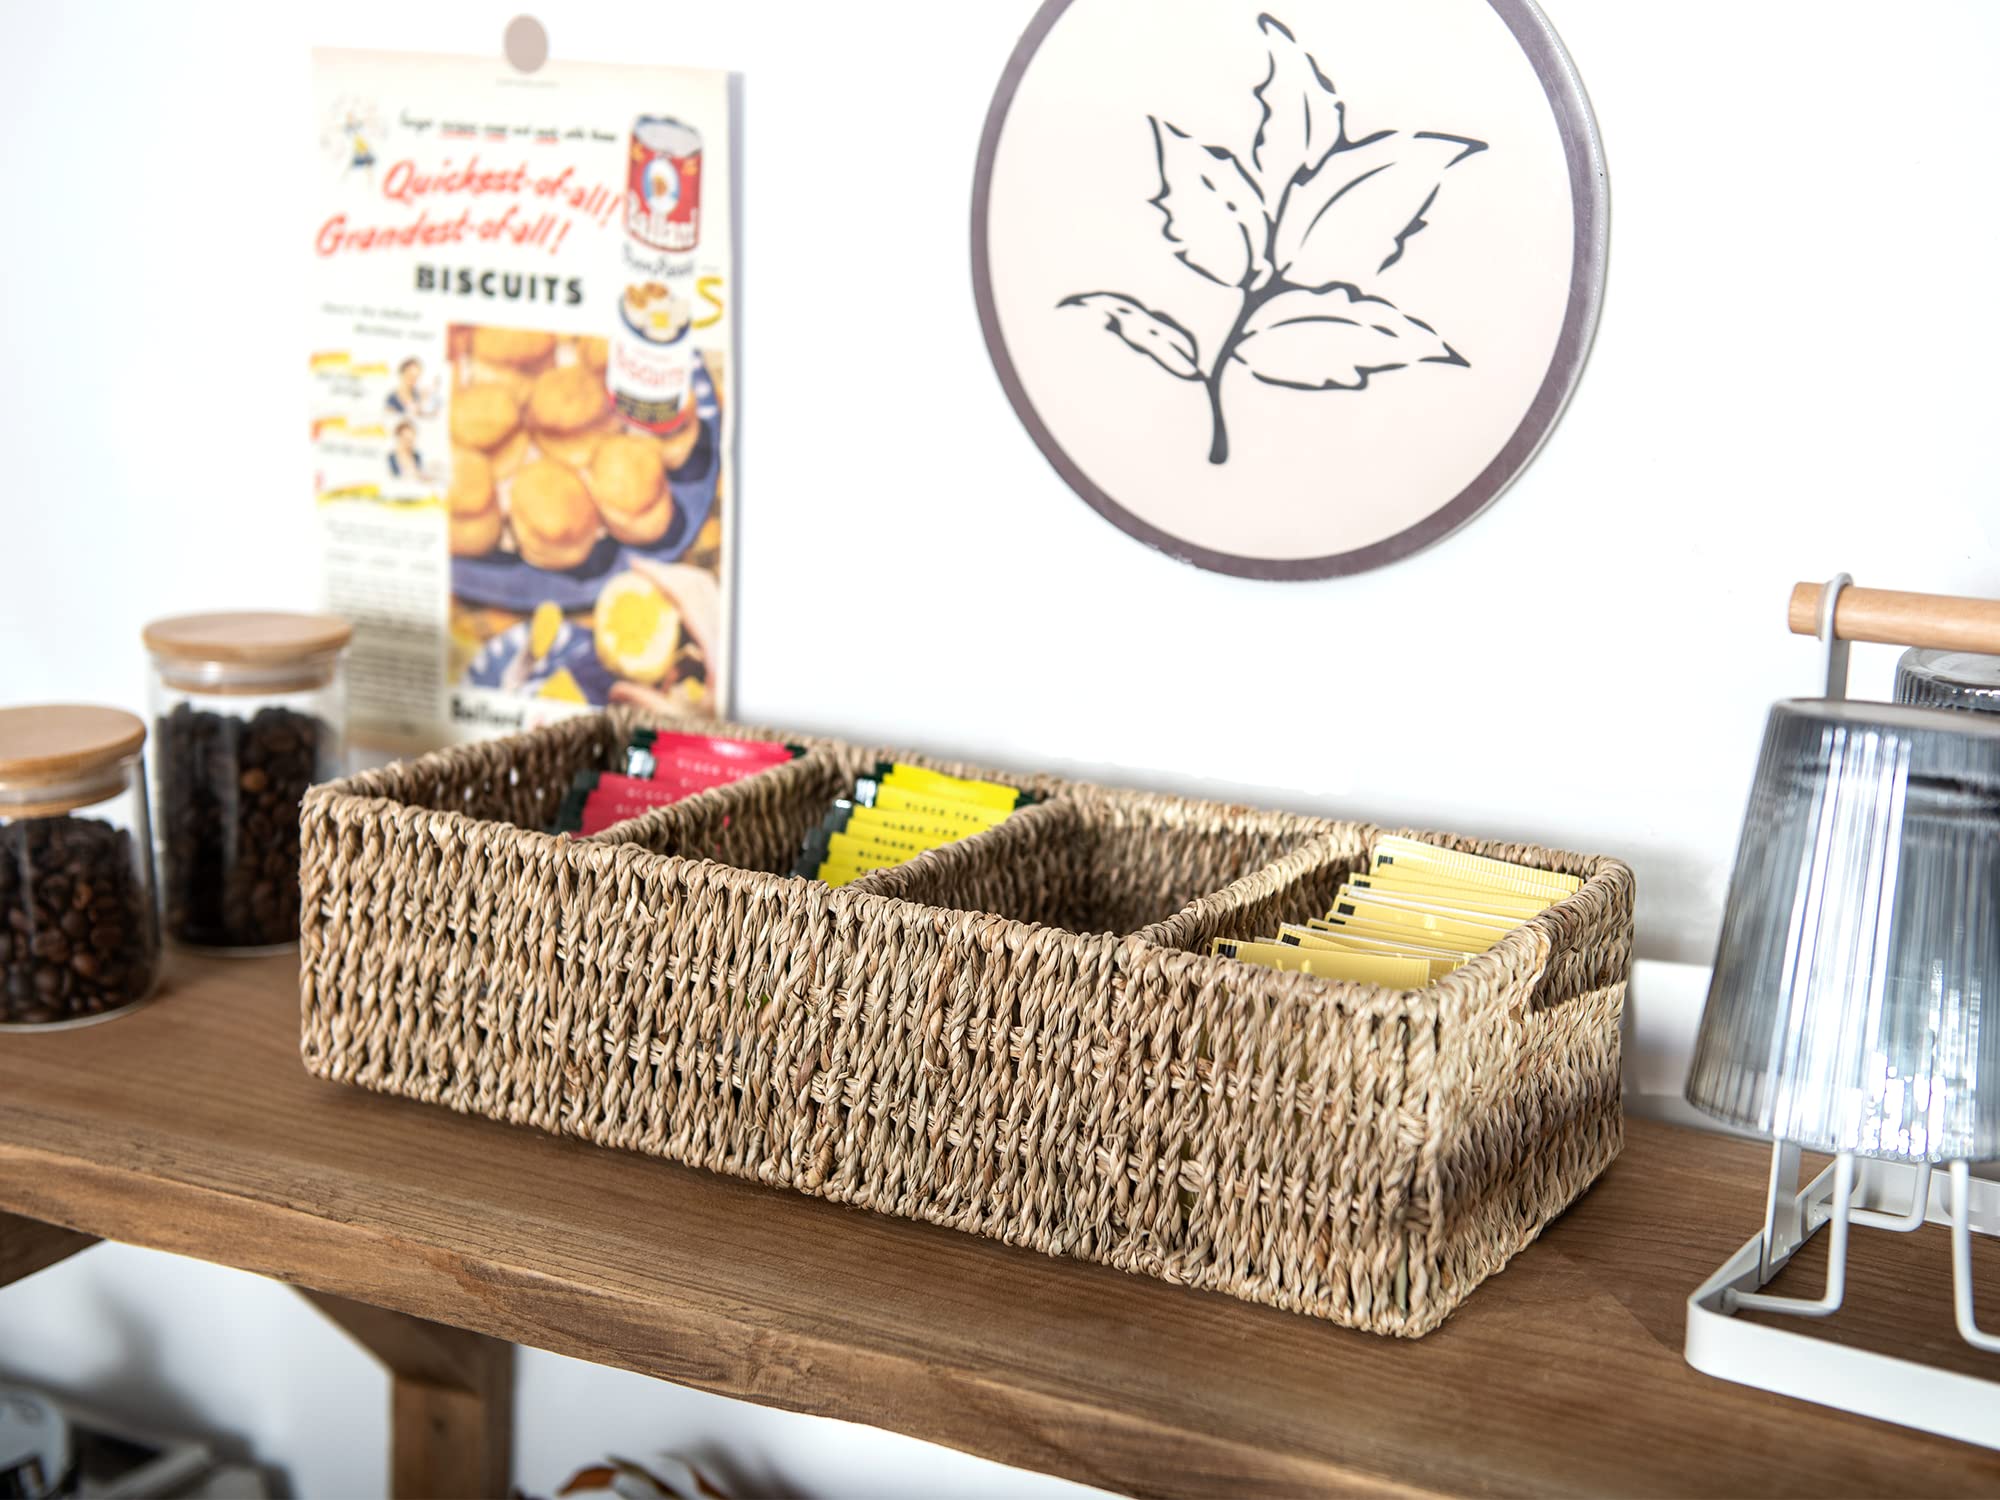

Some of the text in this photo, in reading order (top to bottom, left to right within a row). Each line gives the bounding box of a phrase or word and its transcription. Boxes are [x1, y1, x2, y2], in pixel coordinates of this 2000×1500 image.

[383, 157, 622, 227] Quickest-of-all!
[316, 204, 571, 257] Grandest-of-all!
[415, 265, 583, 305] BISCUITS
